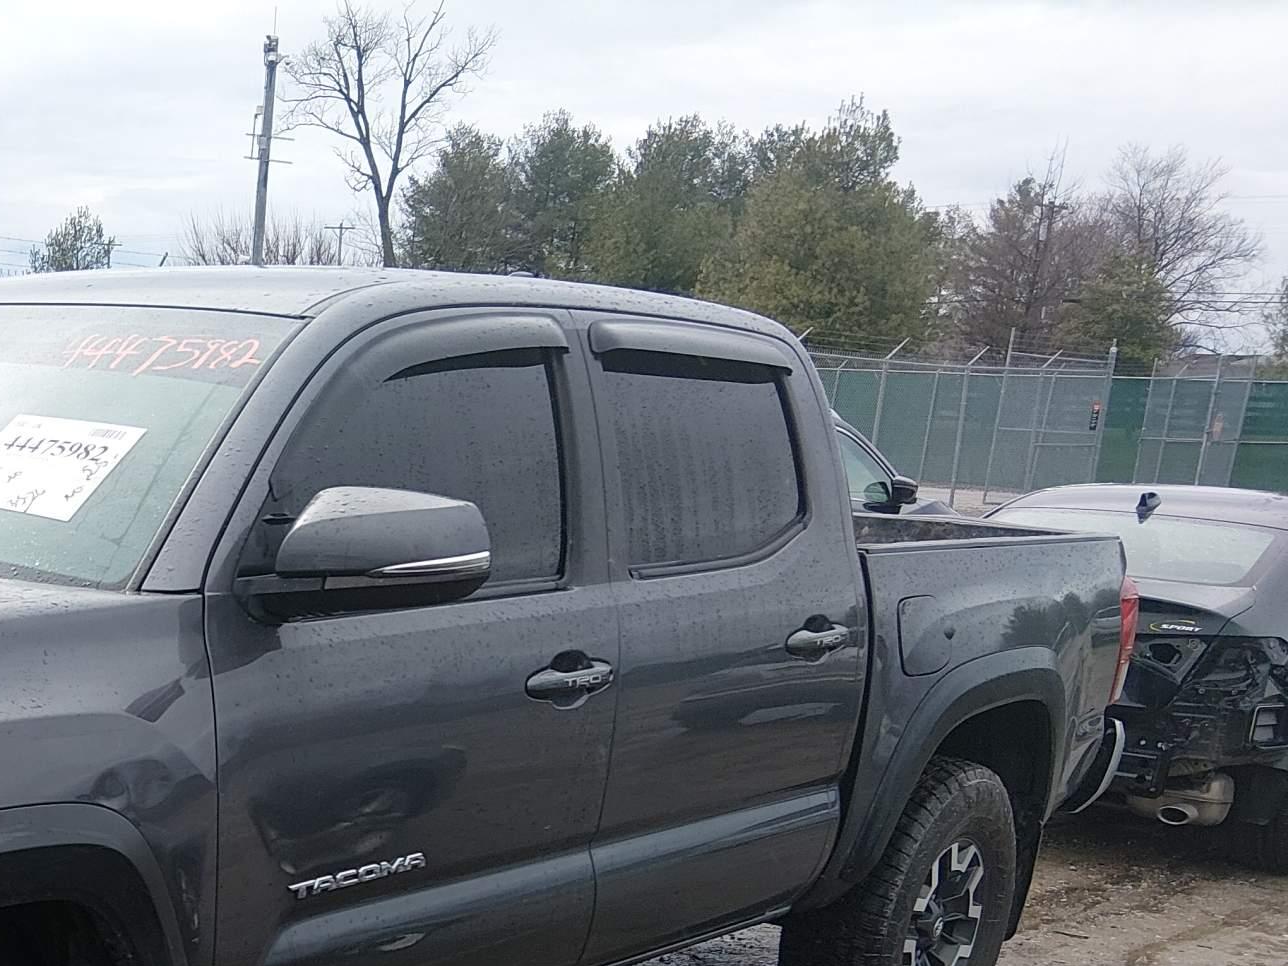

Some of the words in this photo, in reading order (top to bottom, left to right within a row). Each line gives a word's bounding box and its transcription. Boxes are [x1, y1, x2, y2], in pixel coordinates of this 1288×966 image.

[62, 334, 261, 376] 44475982
[3, 435, 109, 462] 44475982
[1160, 623, 1203, 632] SPORT
[287, 852, 426, 899] TACOMA
